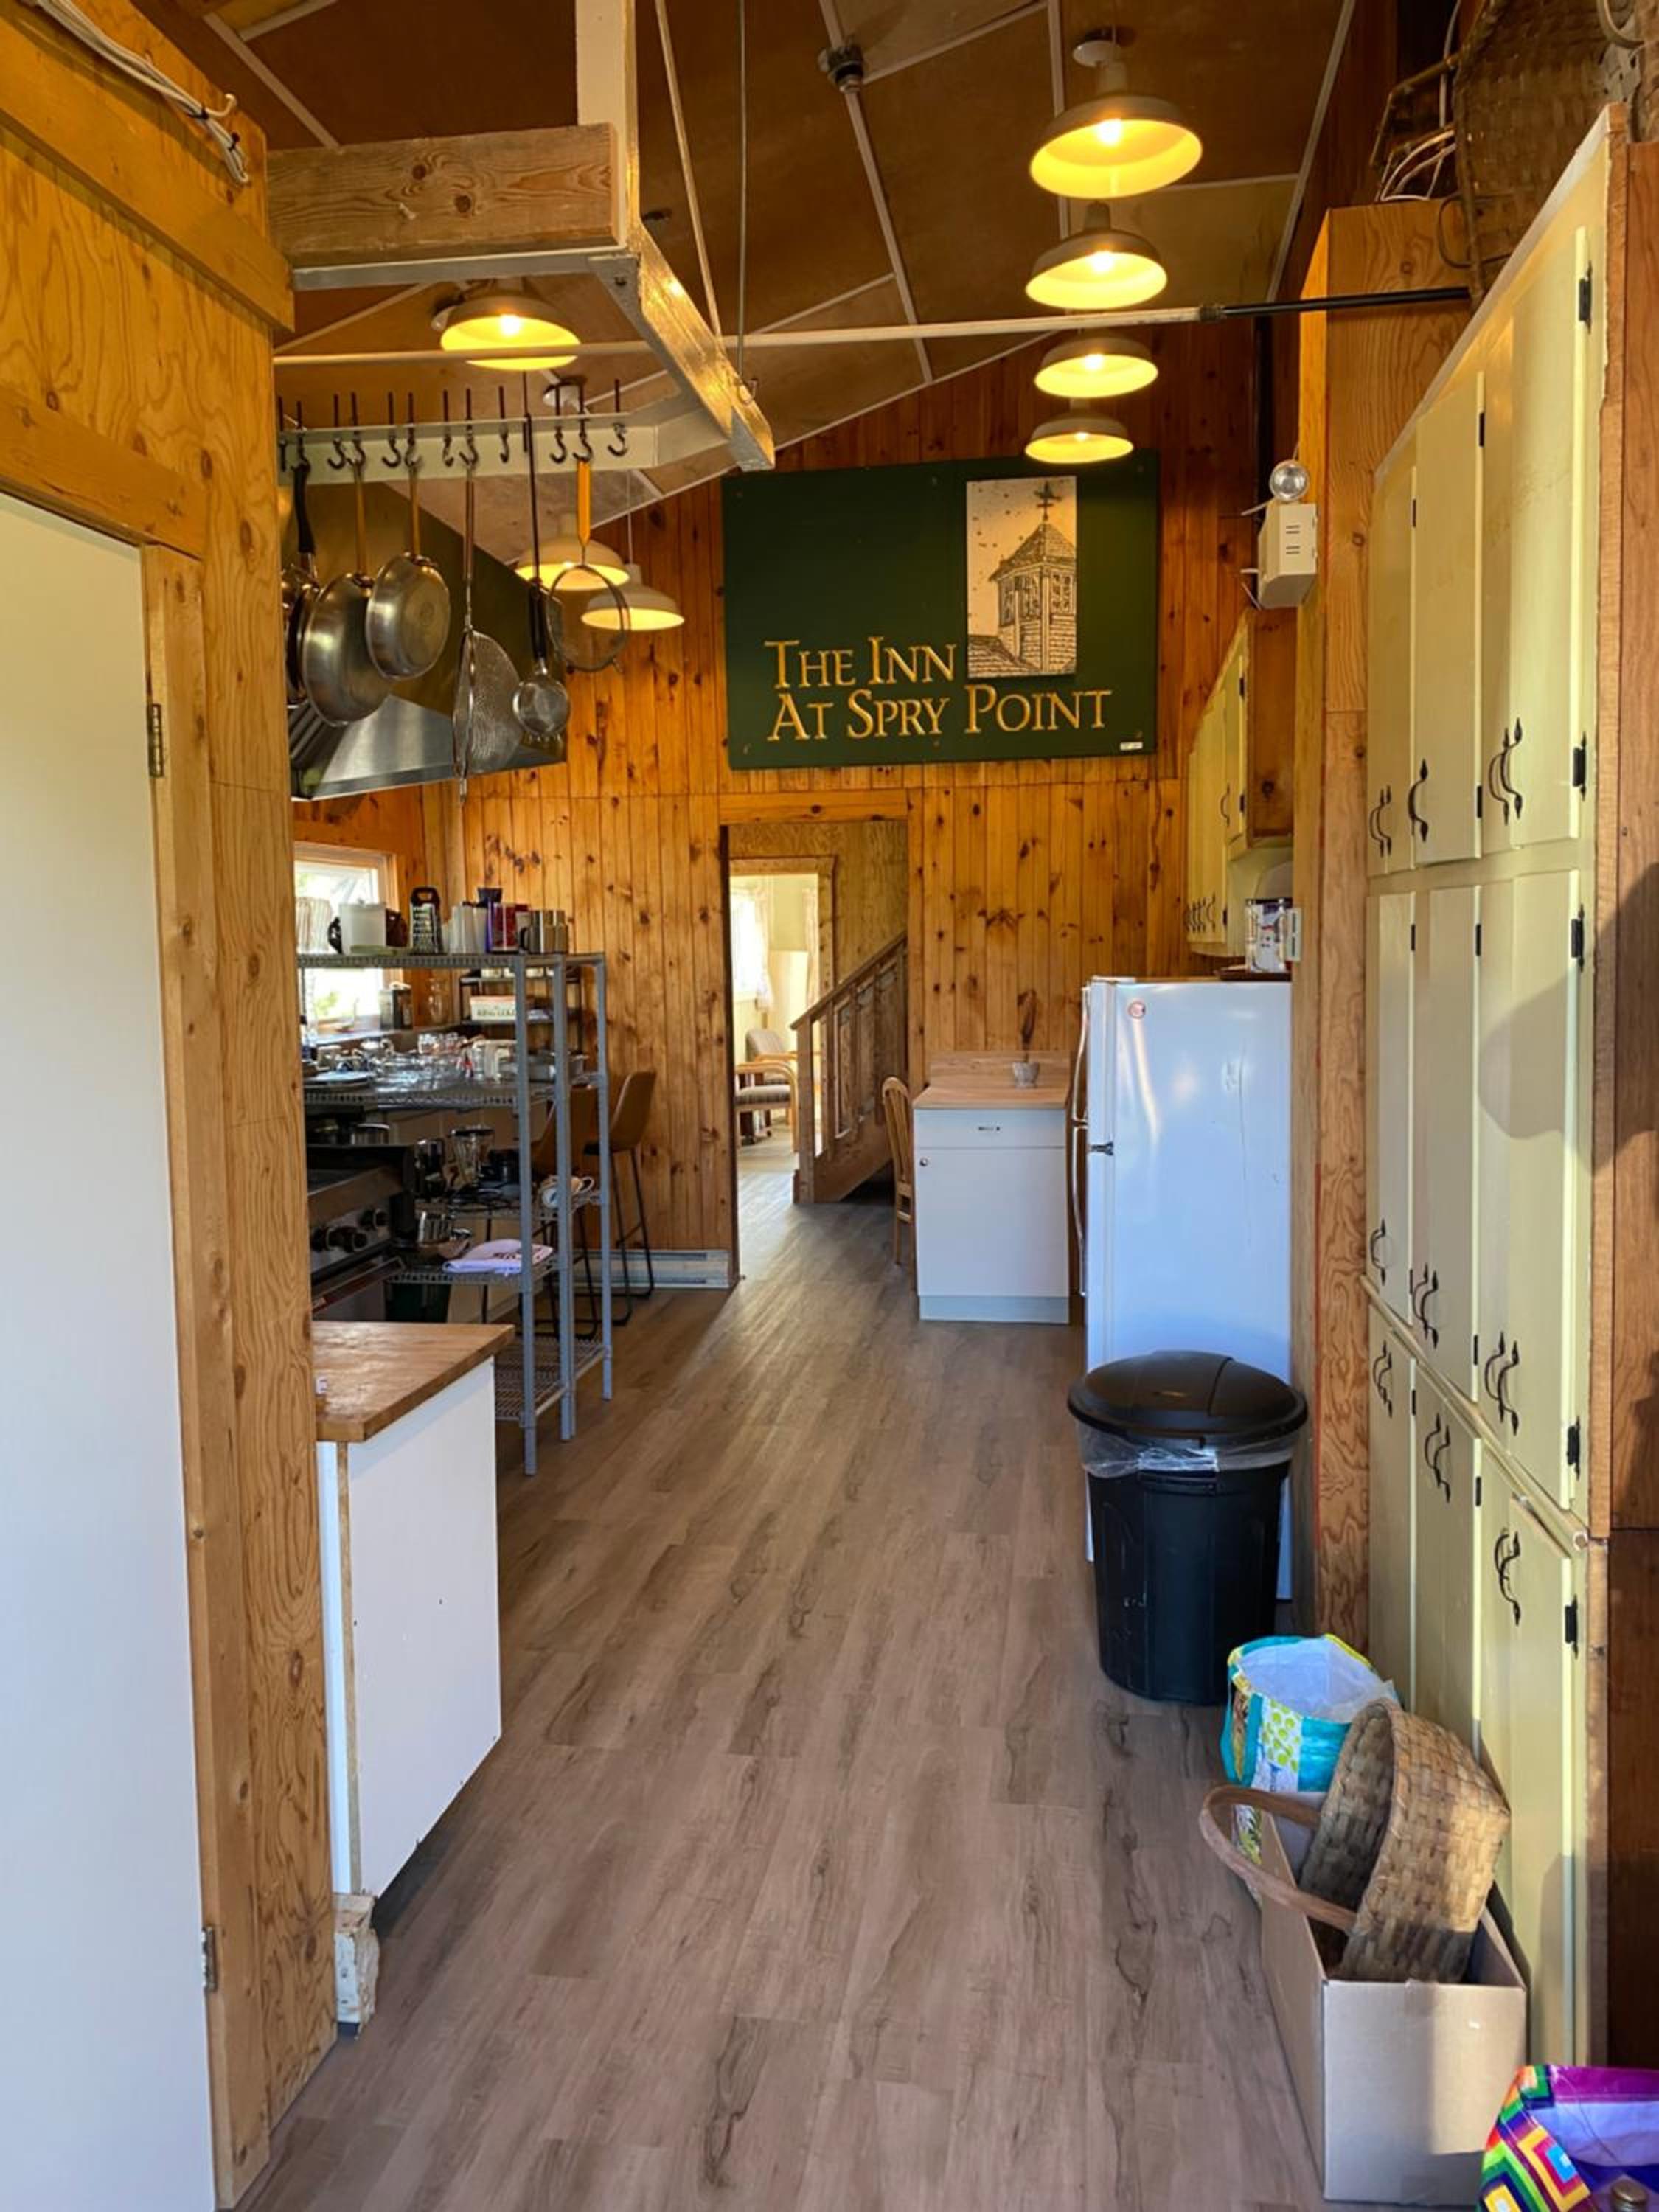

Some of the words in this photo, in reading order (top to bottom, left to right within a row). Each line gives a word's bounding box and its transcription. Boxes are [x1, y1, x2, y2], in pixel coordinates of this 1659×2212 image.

[765, 640, 855, 689] THE
[868, 636, 956, 684] INN
[768, 693, 834, 741] AT
[847, 689, 949, 738] SPRY
[965, 684, 1112, 734] POINT
